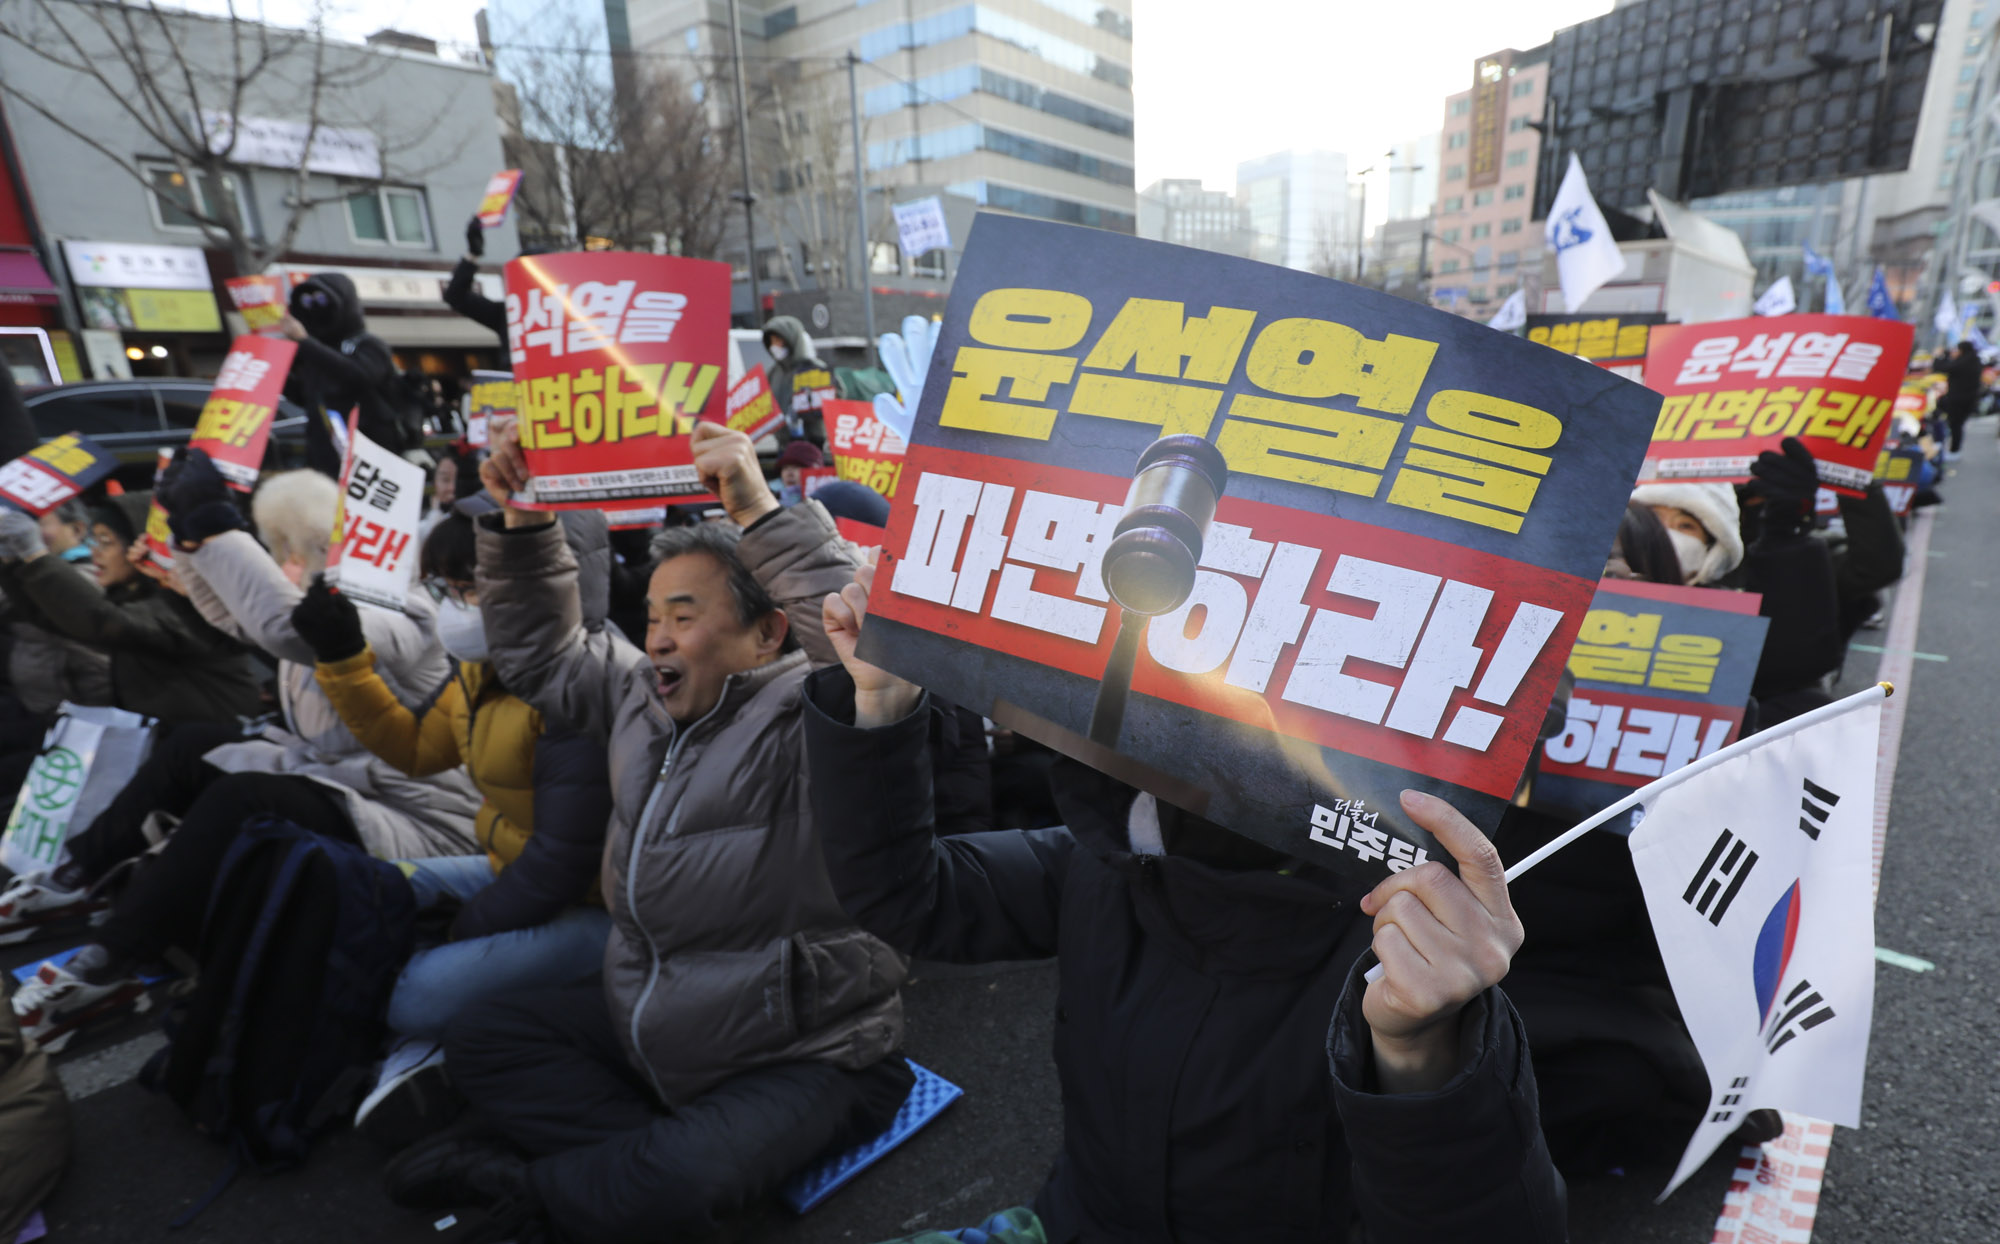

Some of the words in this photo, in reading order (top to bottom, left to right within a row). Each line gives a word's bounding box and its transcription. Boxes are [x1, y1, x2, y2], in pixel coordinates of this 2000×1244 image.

[507, 280, 688, 364] 윤석열을
[1674, 332, 1883, 385] 윤석열을
[939, 288, 1562, 534] 윤석열을
[1651, 386, 1892, 448] 파면하라!
[891, 472, 1564, 751] 파면하라!
[1309, 804, 1429, 874] 민주당
[1334, 799, 1379, 827] 더불어
